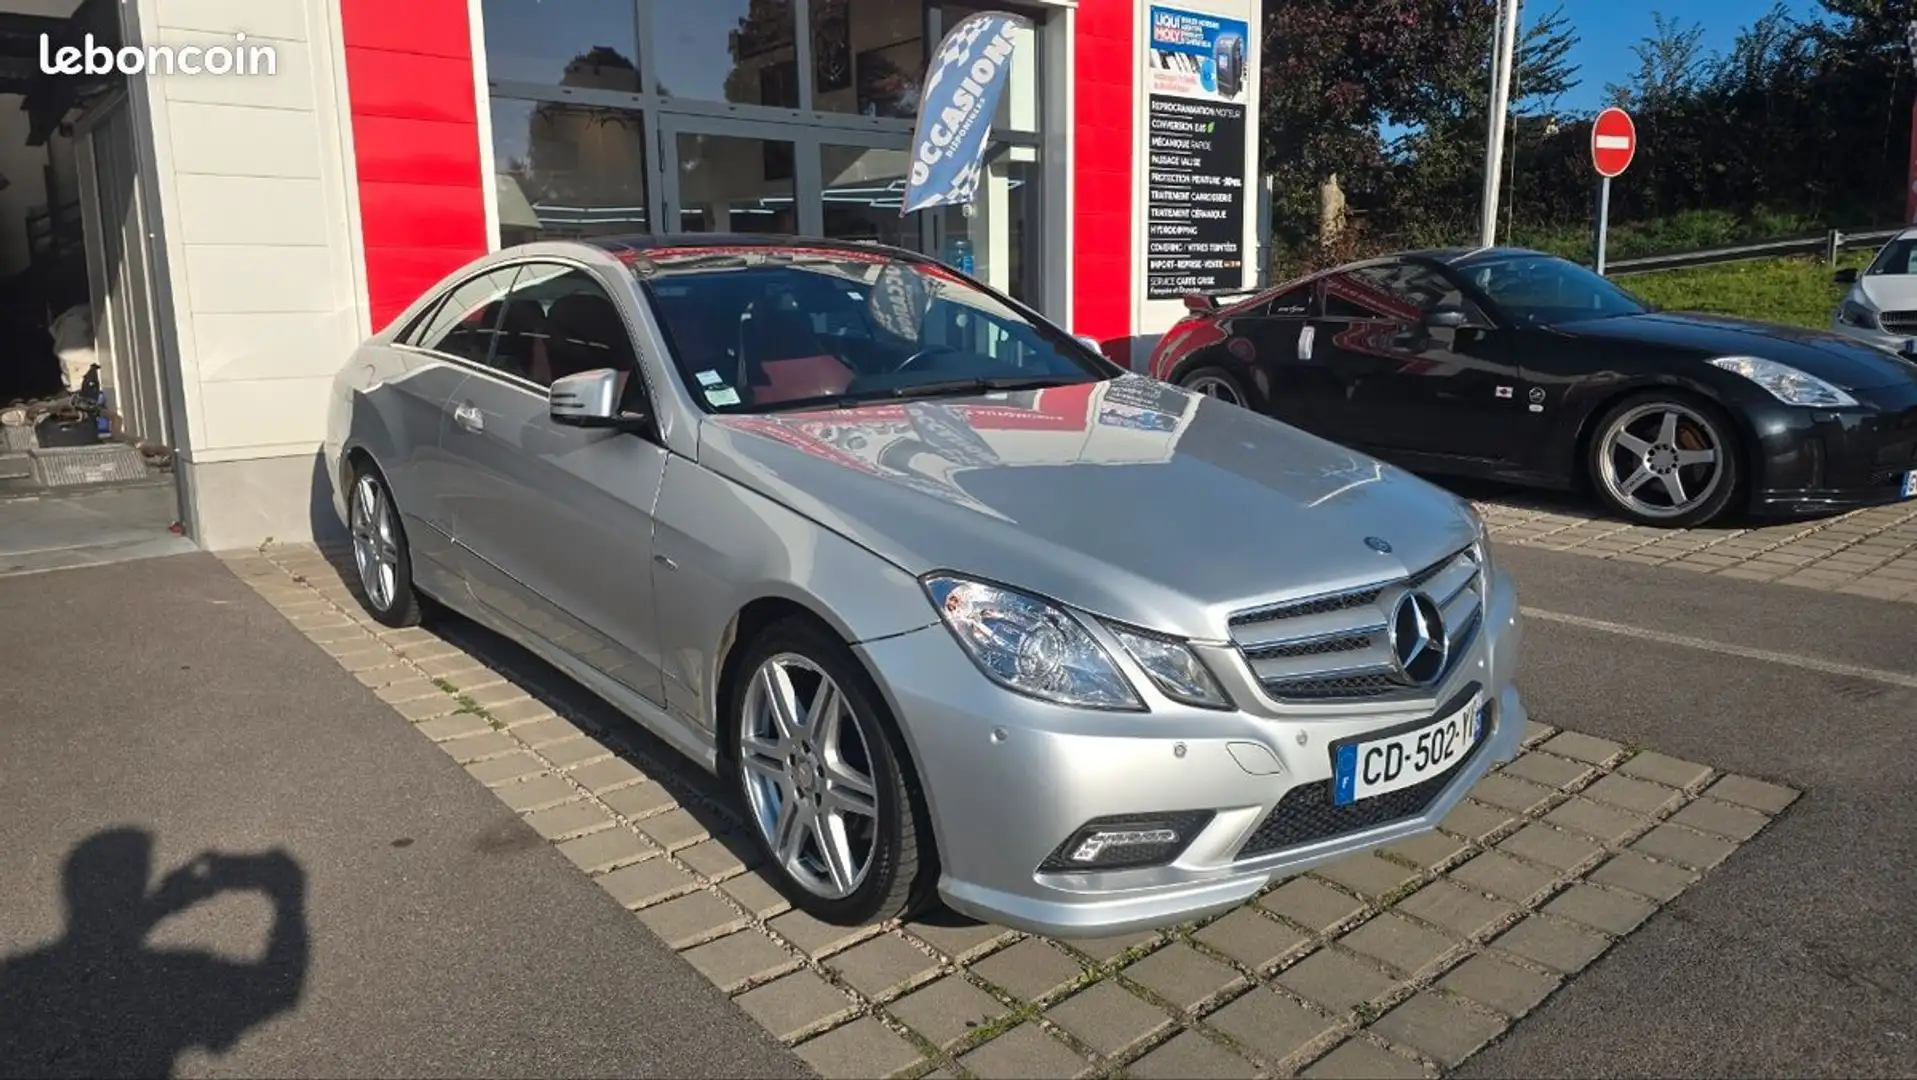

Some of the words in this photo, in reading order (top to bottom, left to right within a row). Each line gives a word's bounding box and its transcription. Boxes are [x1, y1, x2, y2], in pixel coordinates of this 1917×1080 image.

[1155, 12, 1180, 29] LIQUI
[1155, 25, 1180, 41] MOLY
[910, 20, 1017, 186] OCCASIONS
[1216, 108, 1240, 118] MOTEUR
[945, 98, 985, 158] DISPONIBLES
[1151, 119, 1193, 131] CONVERSION
[1151, 137, 1189, 149] MÉCANIQUE
[1151, 155, 1179, 166] PASSAGE
[1151, 172, 1190, 183] PROTECTION
[1151, 190, 1190, 201] TRAITEMENT
[1191, 192, 1232, 202] CARROSSERIE
[1151, 208, 1190, 218] TRAITEMENT
[1191, 207, 1227, 219] CÉRAMIQUE
[1150, 276, 1175, 286] SERVICE
[1176, 276, 1196, 286] CARTE
[1197, 276, 1215, 285] GRISE
